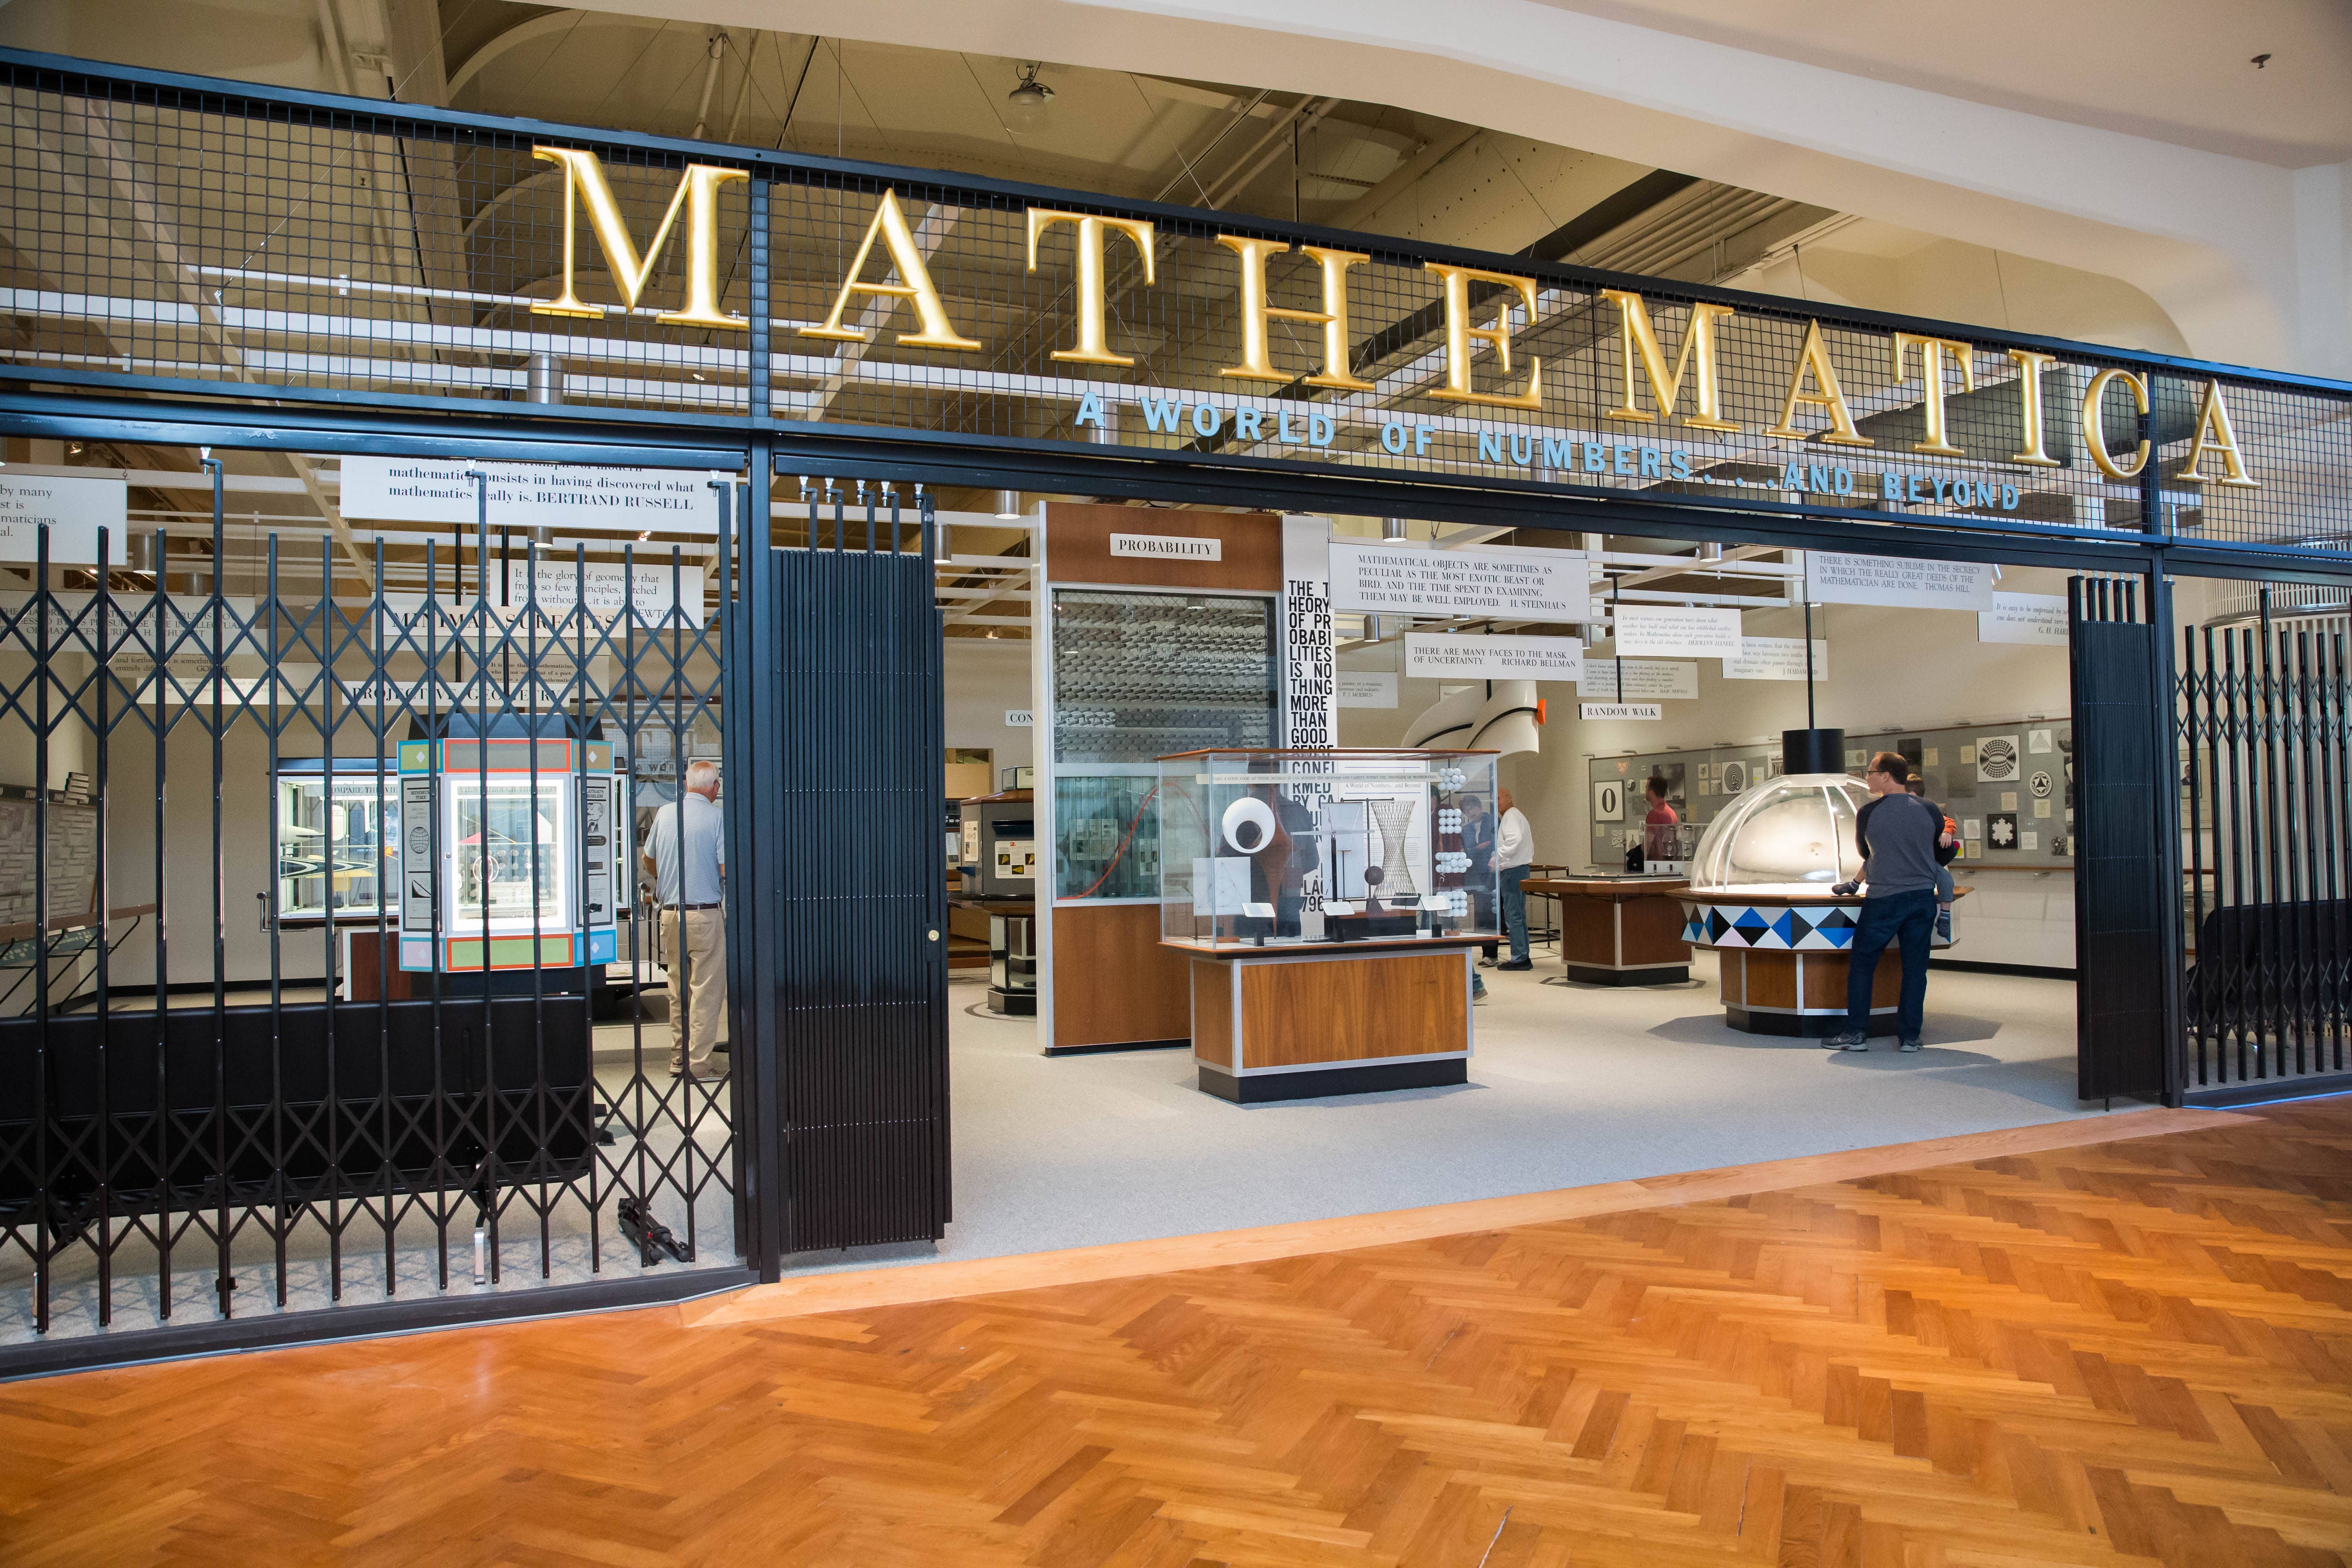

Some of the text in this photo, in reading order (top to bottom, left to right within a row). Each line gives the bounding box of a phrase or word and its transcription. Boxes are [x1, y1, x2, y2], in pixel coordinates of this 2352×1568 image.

[530, 144, 2261, 489] MATHEMATICA
[1074, 391, 1105, 427] A
[1139, 396, 1335, 447] WORLD
[1382, 421, 1436, 456] OF
[1783, 461, 1853, 496] AND
[1883, 471, 2019, 511] BEYOND
[389, 467, 466, 481] mathematic
[534, 474, 546, 485] in
[551, 475, 593, 489] having
[597, 477, 661, 492] discovered
[666, 481, 695, 493] what
[0, 484, 52, 499] by many
[389, 486, 473, 500] mathematics
[519, 491, 532, 502] is.
[536, 491, 620, 506] BERTRAND
[624, 496, 694, 510] RUSSELL
[16, 500, 24, 509] is
[1119, 539, 1214, 555] PROBABILITY
[1358, 555, 1430, 567] MATHEMATICAL
[1433, 560, 1469, 570] OBJECTS
[1472, 562, 1489, 571] ARE
[1492, 564, 1539, 573] SOMETIMES
[1818, 555, 1842, 565] THERE
[1845, 557, 1851, 565] IS
[1853, 558, 1894, 568] SOMETHING
[1896, 561, 1925, 570] SUBLIME
[1937, 564, 1950, 572] THE
[1952, 565, 1981, 574] SECRECY
[515, 568, 523, 578] It
[537, 569, 553, 579] the
[641, 573, 660, 583] that
[1359, 567, 1544, 586] PECULIAR AS THE MOST EXOTIC BEAST OR
[1820, 566, 1827, 574] IN
[1830, 566, 1855, 576] WHICH
[1858, 568, 1872, 577] THE
[1875, 569, 1899, 578] REALLY
[1902, 571, 1924, 580] GREAT
[1926, 573, 1947, 582] DEEDS
[1960, 575, 1974, 583] THE
[555, 582, 571, 592] few
[1289, 580, 1313, 597] THE
[1359, 579, 1542, 597] BIRD. AND THE TIME SPENT IN EXAMINING
[1820, 576, 1879, 587] MATHEMATICIAN
[1882, 580, 1895, 588] ARE
[1924, 582, 1953, 592] THOMAS
[1955, 584, 1970, 593] HILL
[603, 597, 610, 605] is
[1289, 596, 1329, 613] HEORY
[1359, 592, 1566, 609] THEM MAY BE WELL EMPLOYED. H. STEINHAUS
[1289, 612, 1331, 629] OF PR
[2027, 616, 2053, 624] understand
[2056, 607, 2061, 617] by
[1289, 629, 1331, 646] OBABI
[1289, 645, 1332, 662] LITIES
[1428, 656, 1485, 665] UNCERTAINTY.
[1540, 659, 1575, 667] BELLMAN
[1290, 662, 1332, 679] IS NO
[1290, 678, 1333, 695] THING
[1290, 695, 1328, 711] MORE
[1588, 707, 1656, 716] RANDOM WALK
[1291, 711, 1327, 727] THAN
[1291, 728, 1328, 745] GOOD
